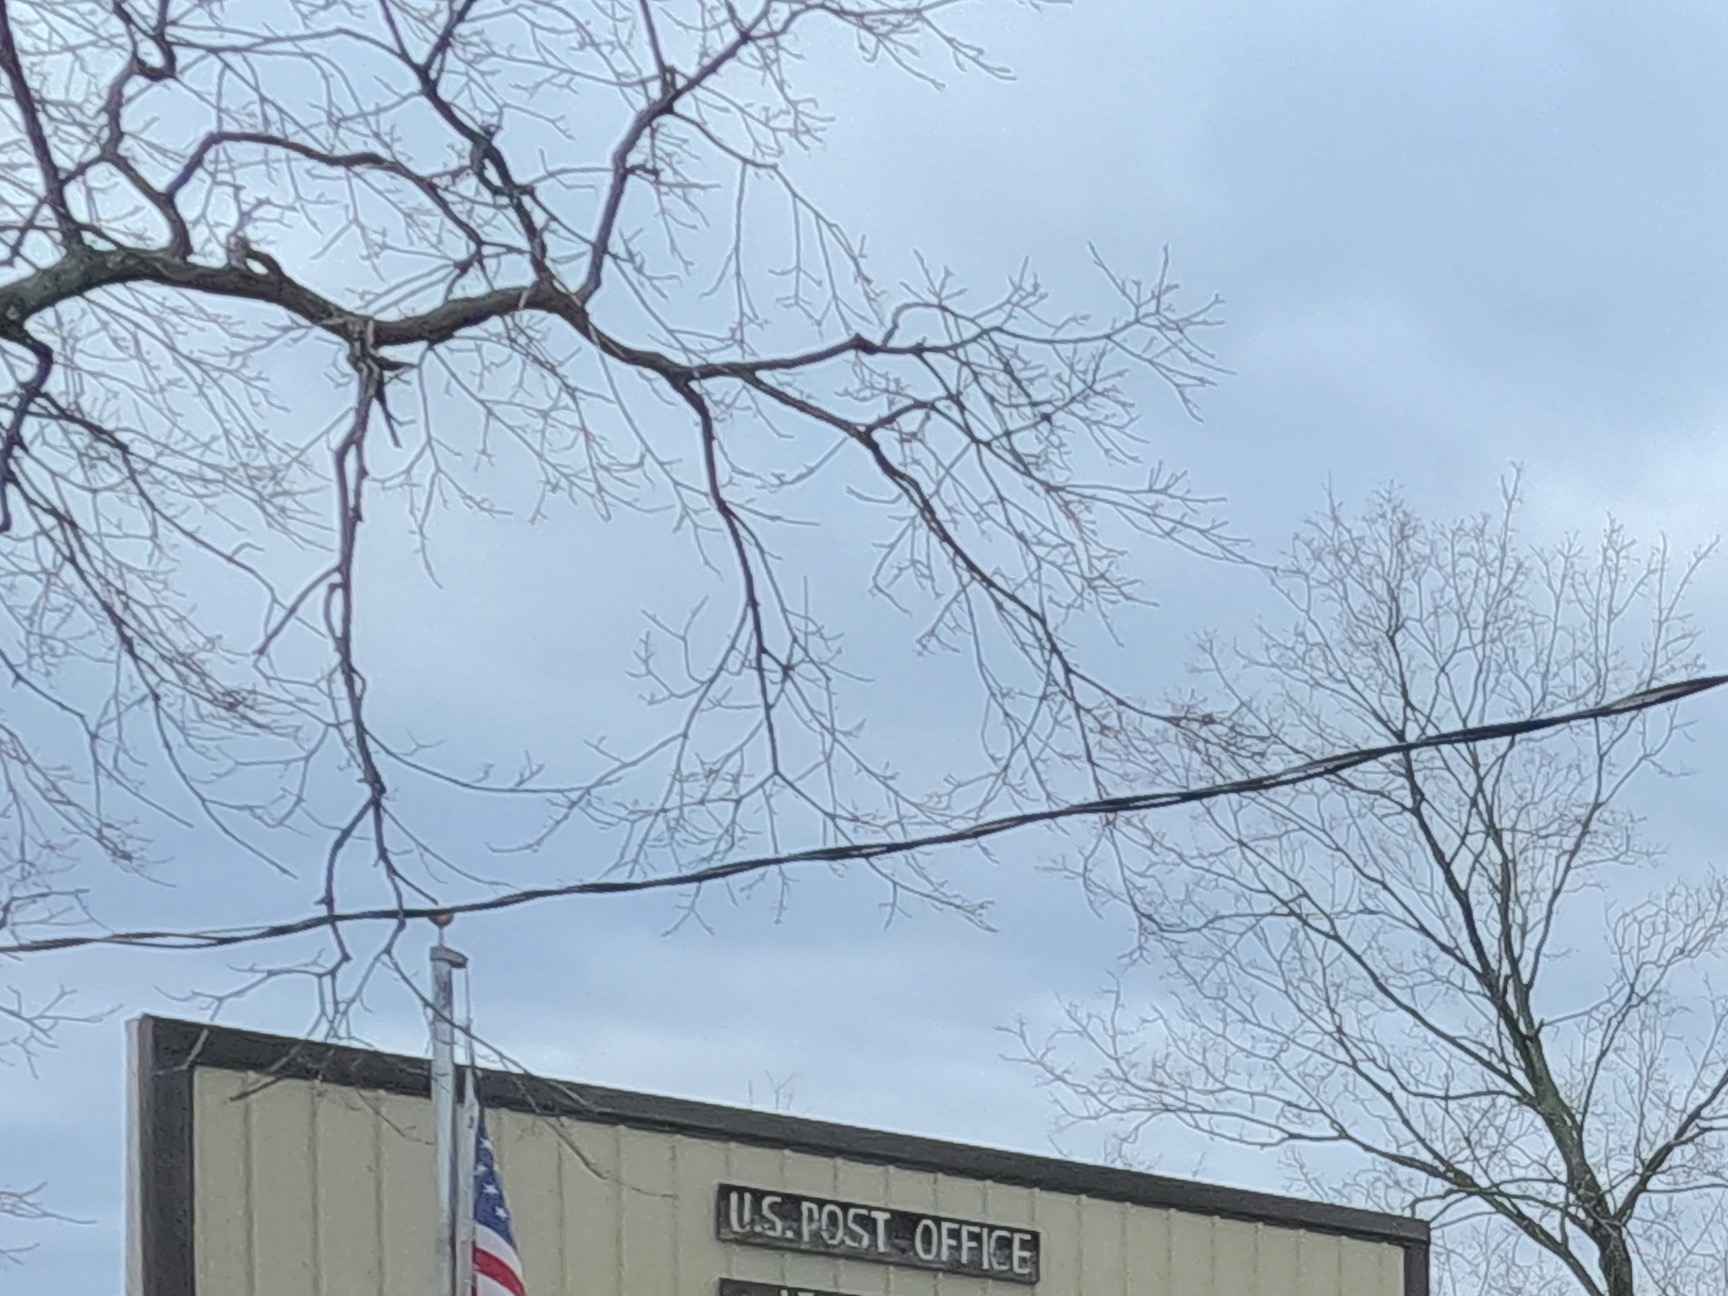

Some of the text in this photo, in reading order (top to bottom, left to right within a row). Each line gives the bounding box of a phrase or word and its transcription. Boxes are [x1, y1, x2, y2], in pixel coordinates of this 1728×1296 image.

[729, 1191, 1032, 1275] U.S. POST OFFICE
